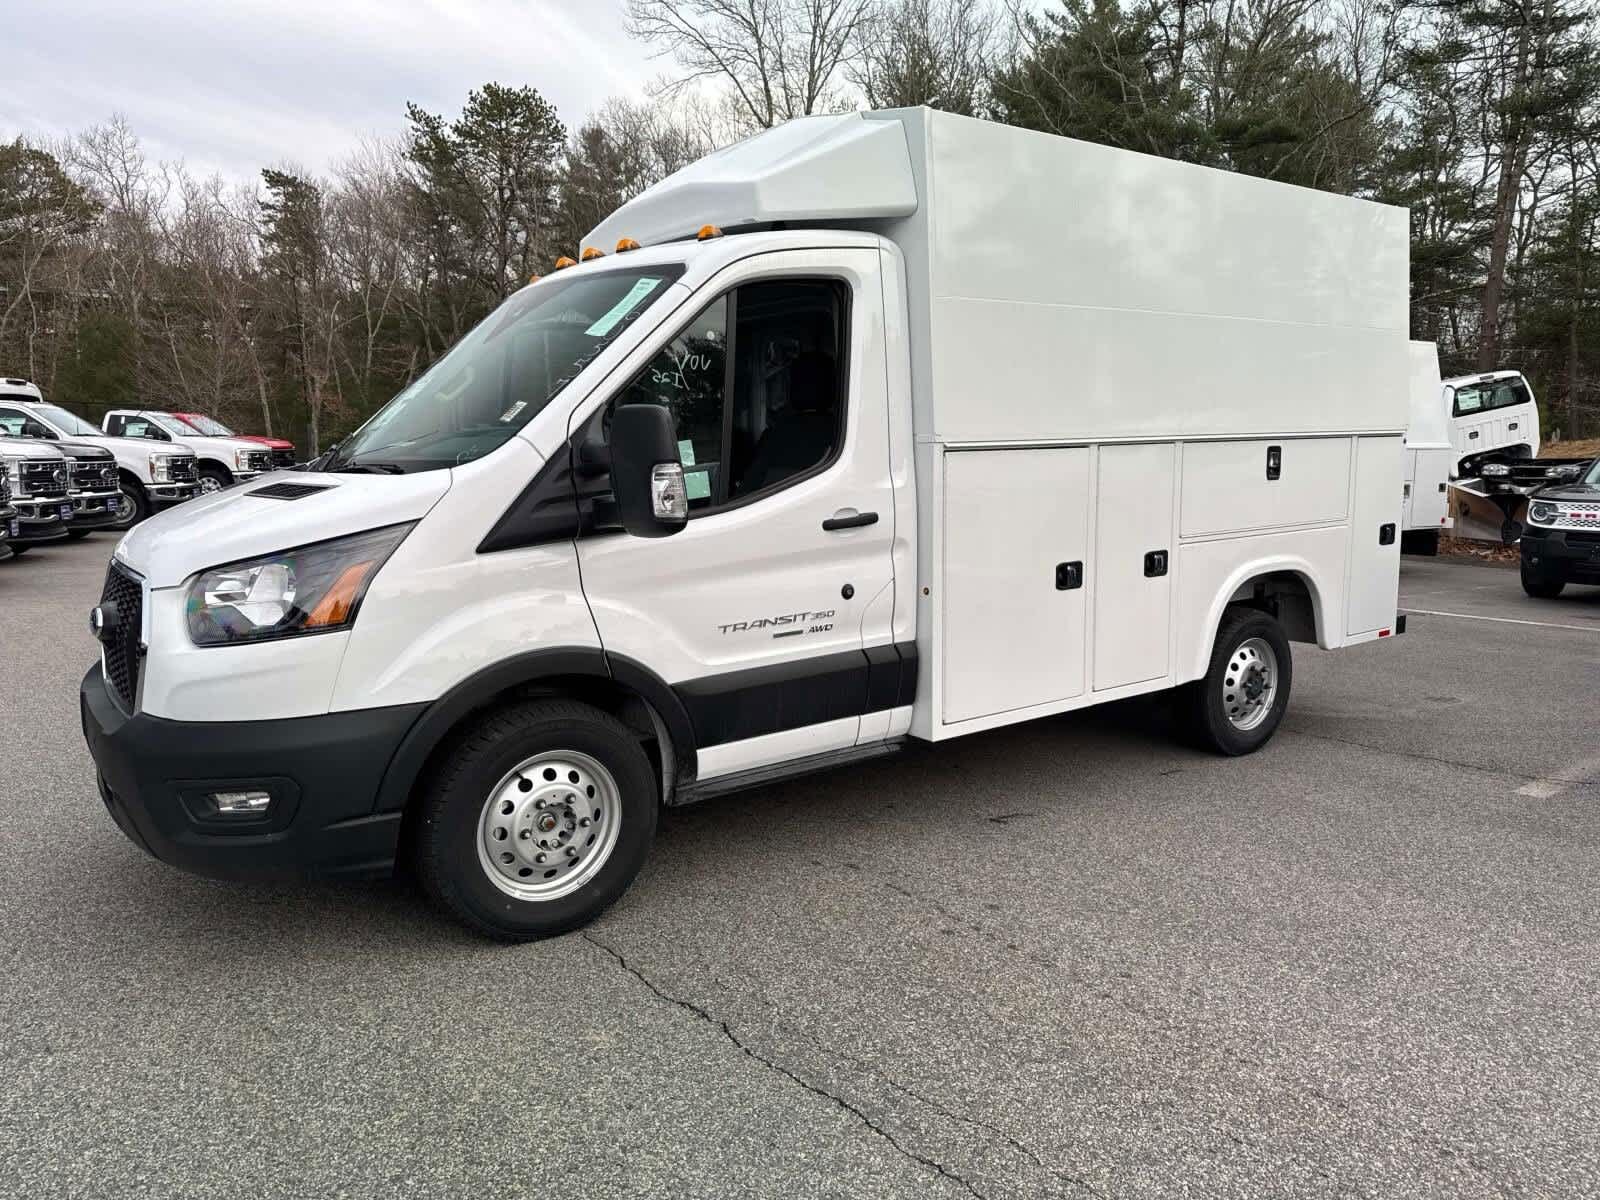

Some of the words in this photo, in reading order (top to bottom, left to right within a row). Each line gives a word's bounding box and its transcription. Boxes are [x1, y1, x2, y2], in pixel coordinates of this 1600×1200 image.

[717, 611, 811, 635] TRANSIT
[810, 609, 836, 621] 350
[807, 623, 834, 634] AWD
